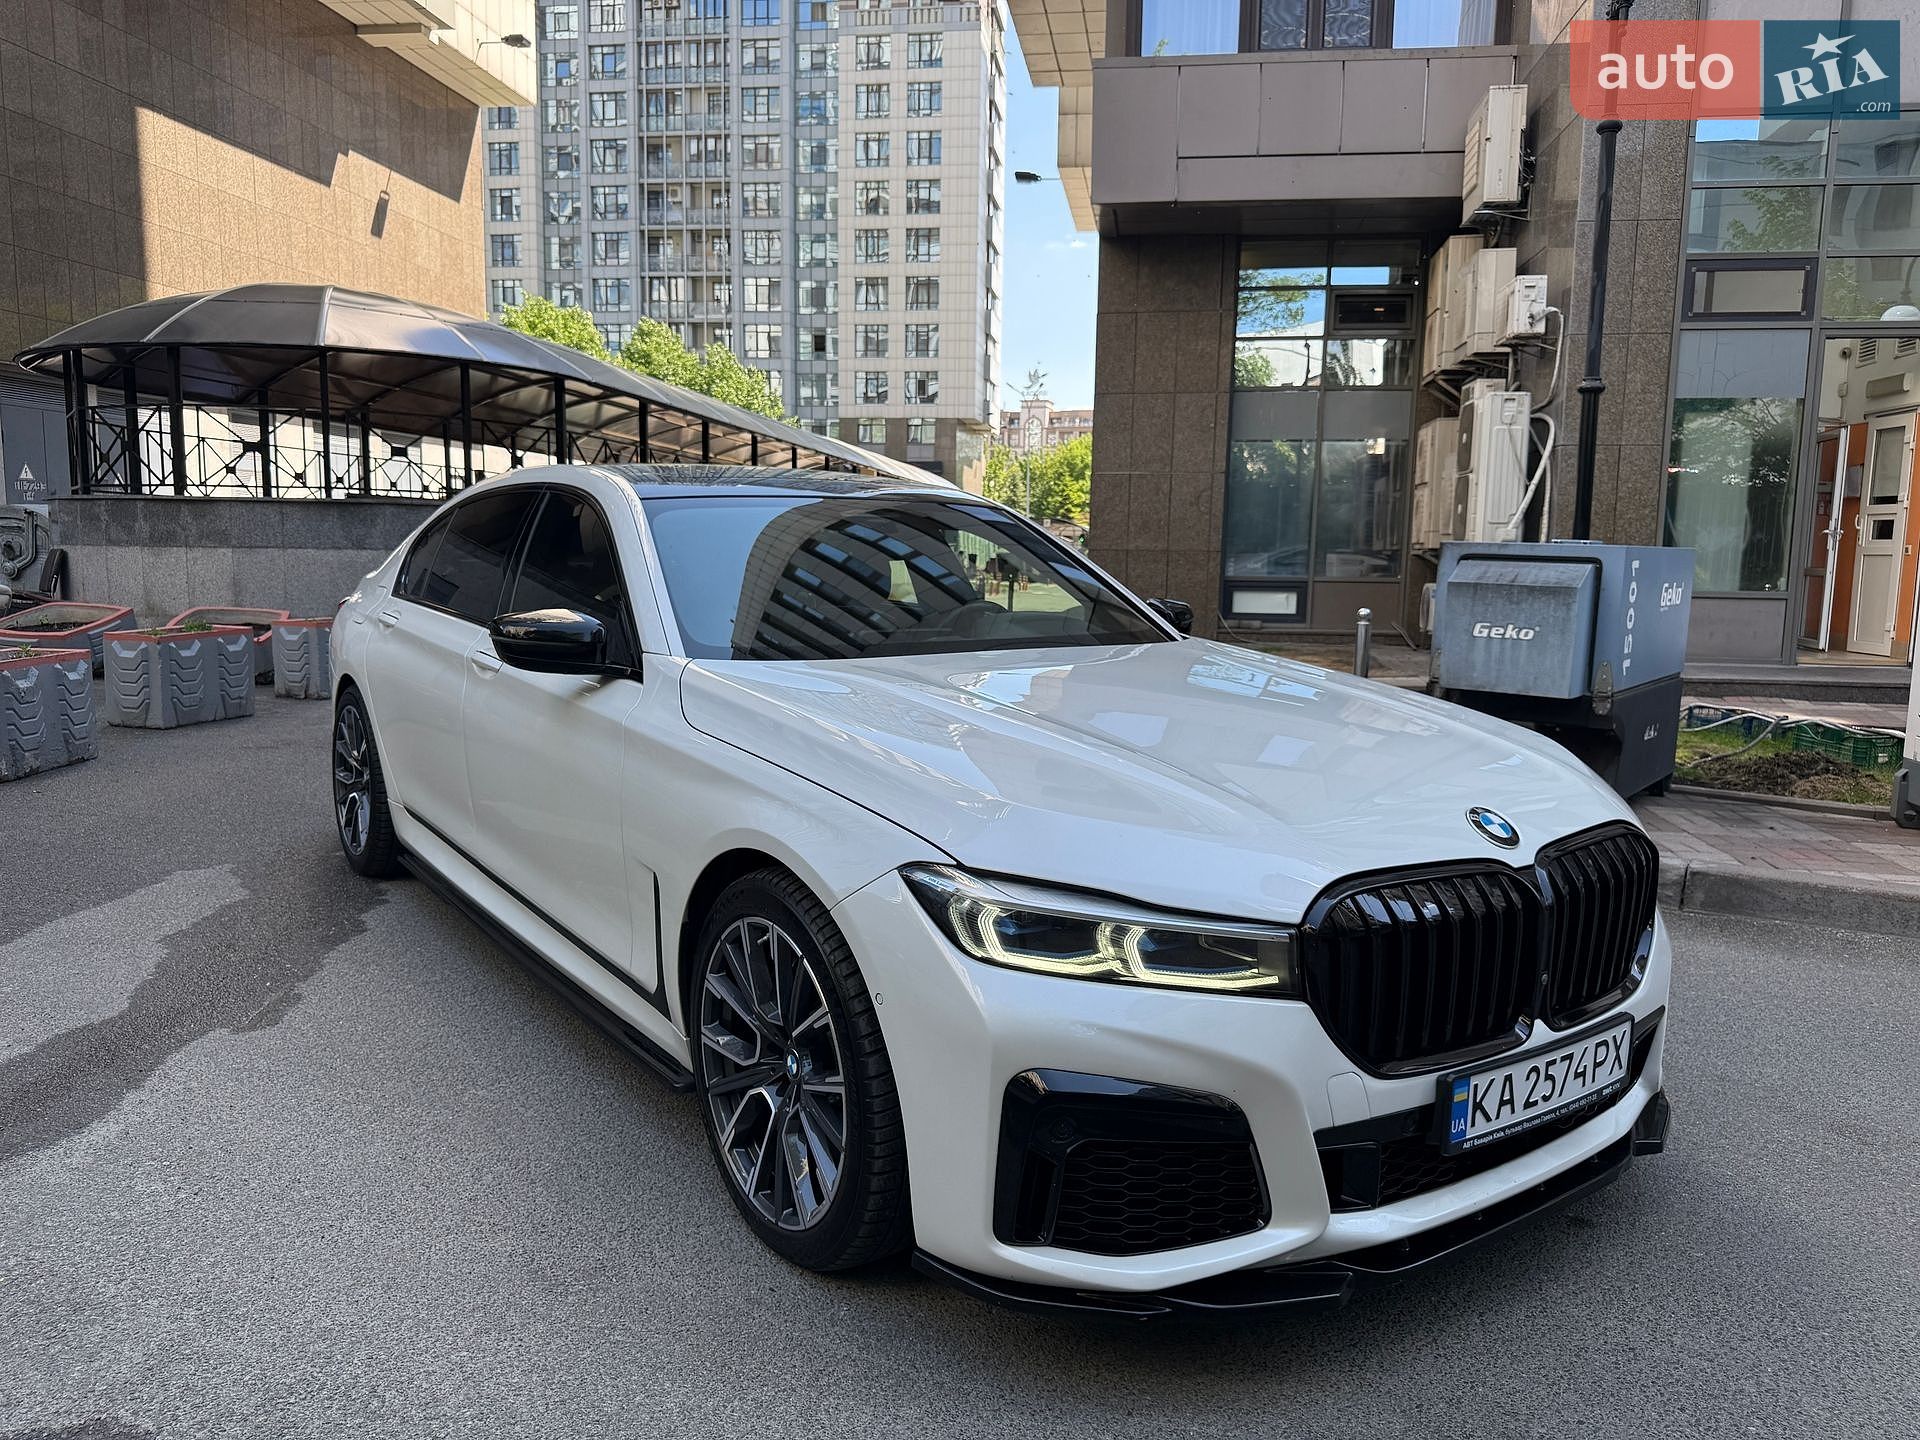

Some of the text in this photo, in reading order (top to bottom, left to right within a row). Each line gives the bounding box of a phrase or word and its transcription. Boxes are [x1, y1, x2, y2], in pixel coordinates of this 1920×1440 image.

[1660, 582, 1682, 606] Geko
[1472, 622, 1536, 640] Geko
[1451, 1117, 1466, 1133] UA
